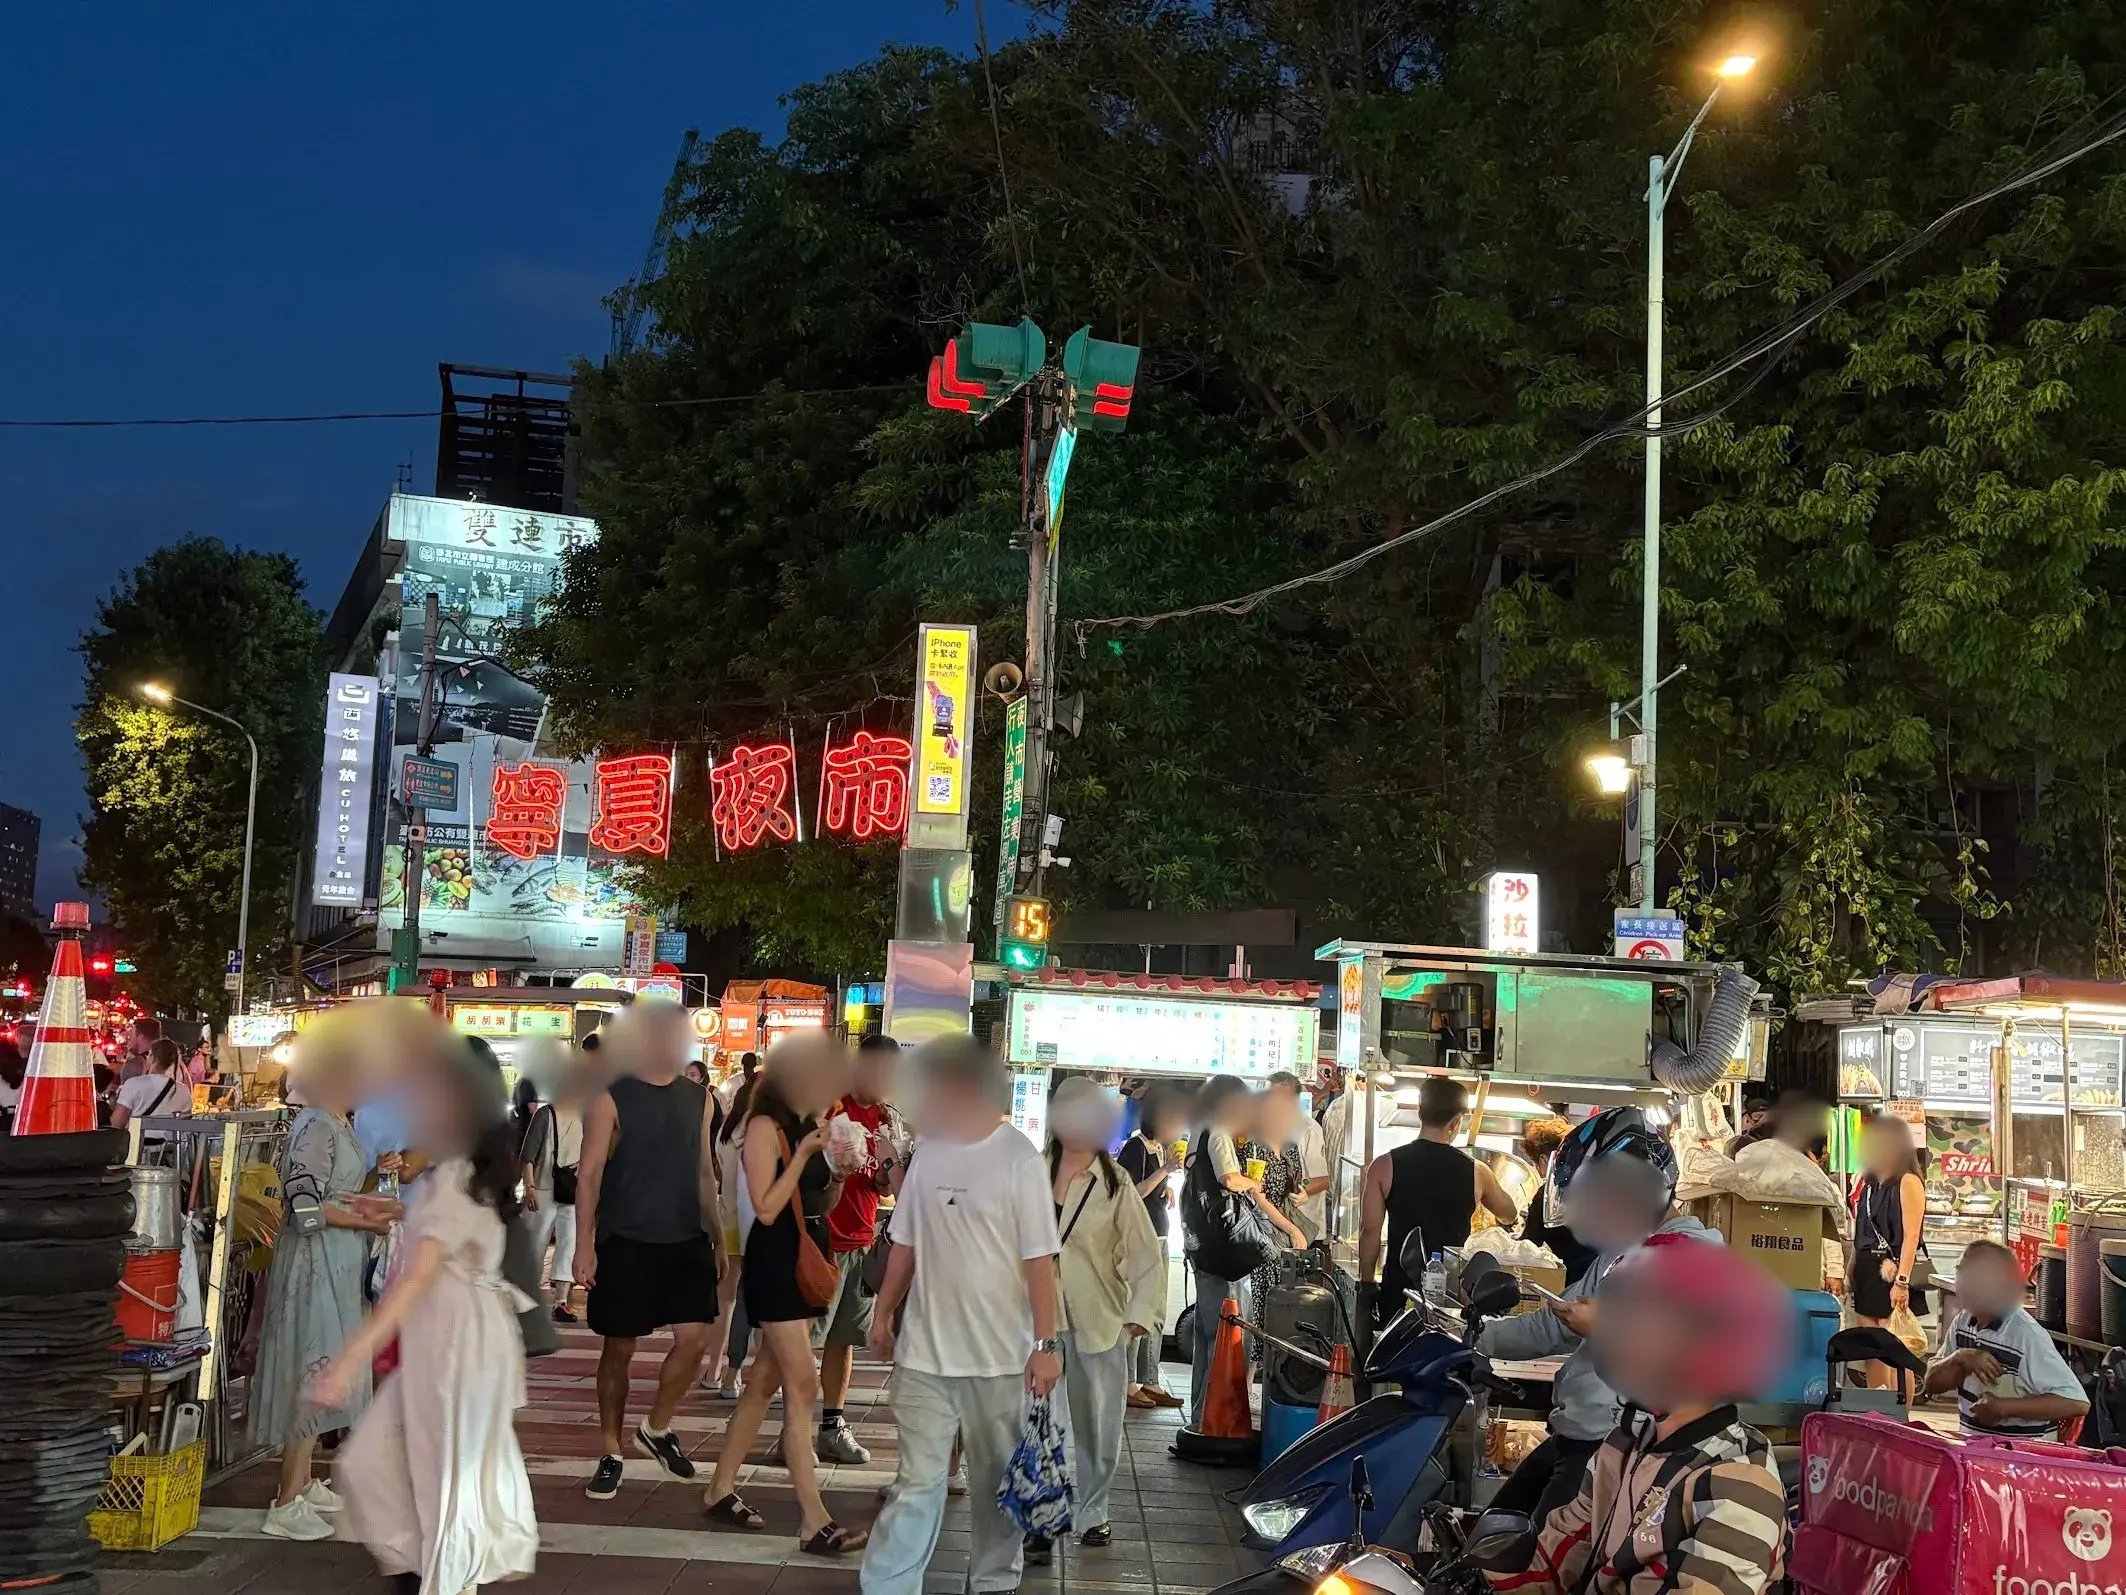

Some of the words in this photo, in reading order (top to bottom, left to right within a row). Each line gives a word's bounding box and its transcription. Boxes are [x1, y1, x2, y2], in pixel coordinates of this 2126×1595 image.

[496, 557, 545, 575] 建成分館
[487, 730, 913, 860] 寧夏夜市
[1005, 702, 1025, 896] 夜市營業時
[1018, 904, 1044, 941] 15
[1503, 878, 1532, 957] 沙拉
[1620, 919, 1681, 931] 家長接送區
[227, 949, 236, 966] P
[522, 1016, 561, 1027] 花生
[1945, 1156, 1992, 1173] Shri
[1751, 1233, 1804, 1251] 裕翔食品
